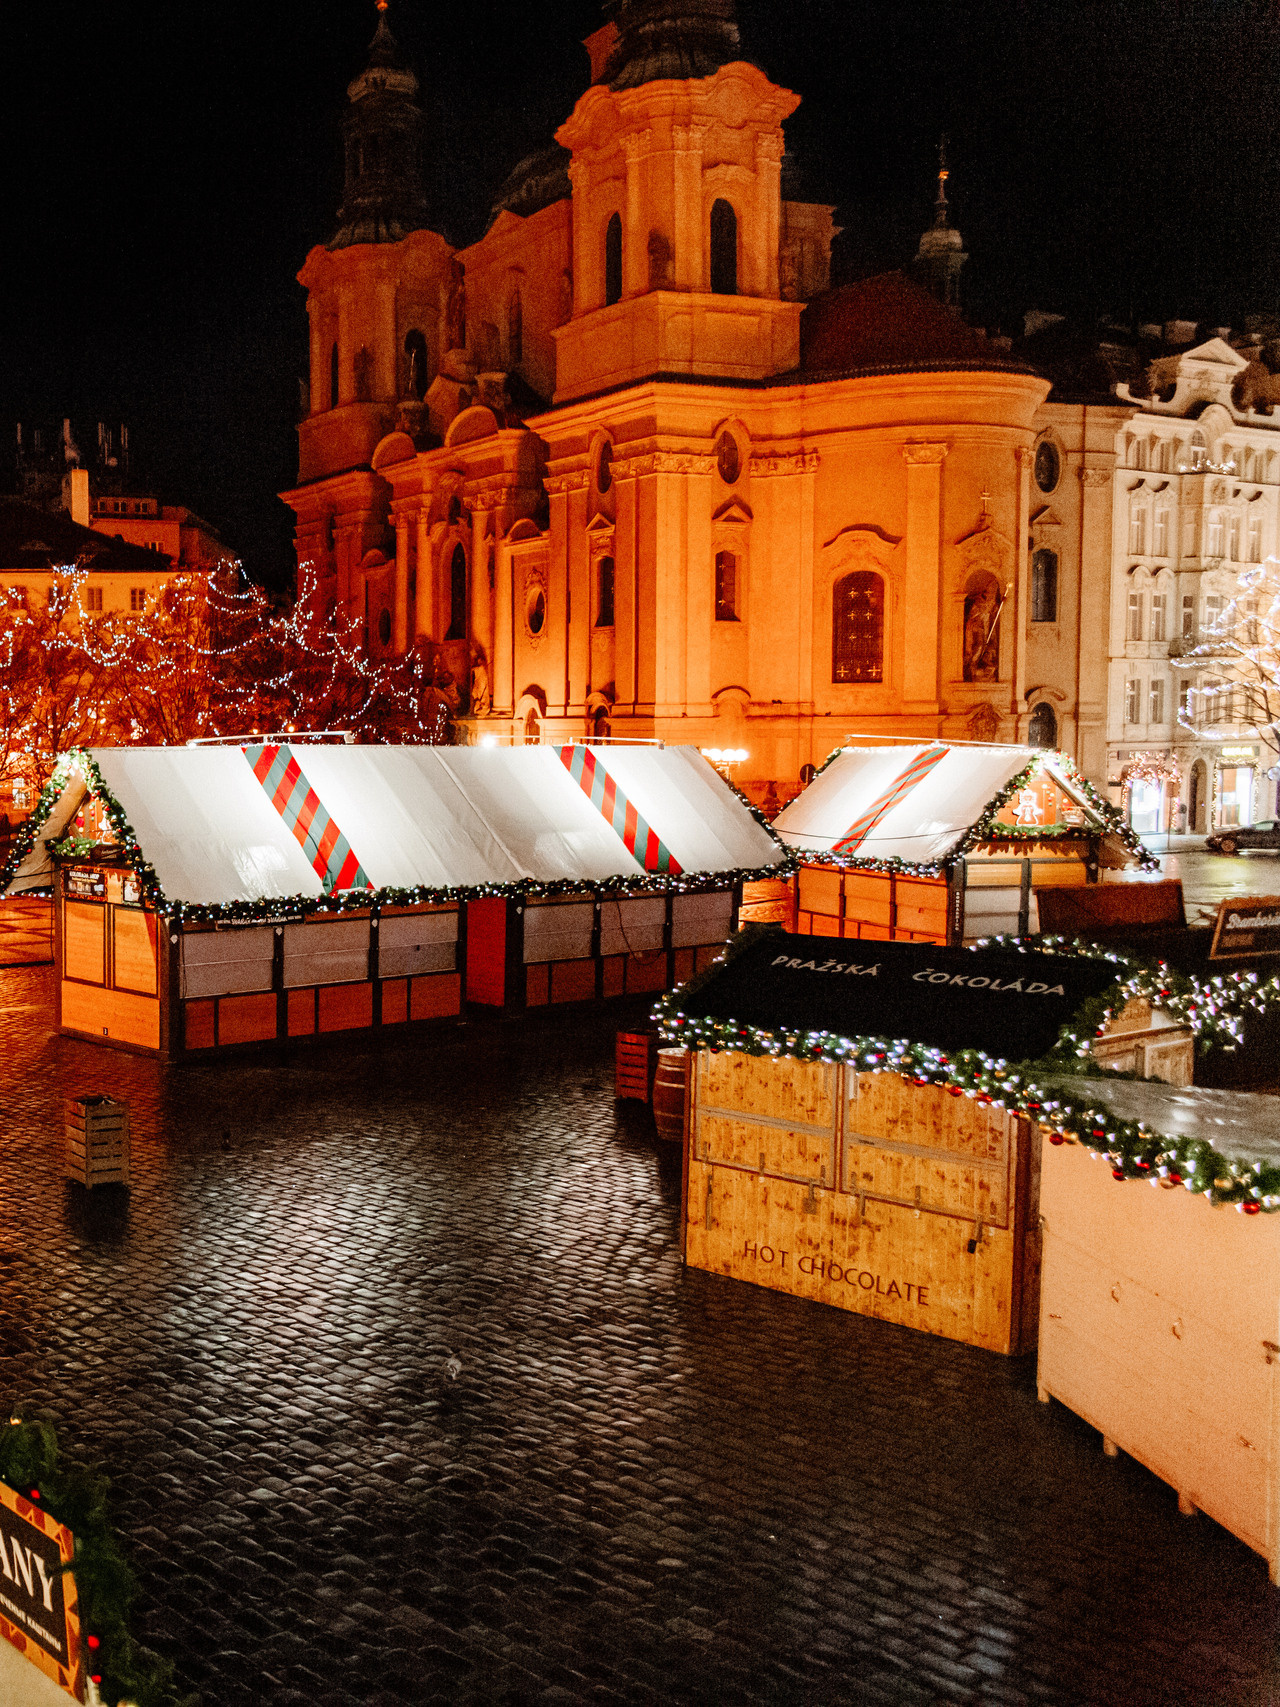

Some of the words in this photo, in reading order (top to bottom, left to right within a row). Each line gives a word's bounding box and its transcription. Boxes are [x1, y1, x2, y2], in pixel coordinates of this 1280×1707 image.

[771, 955, 881, 977] PRAŽSKÁ
[912, 968, 1065, 996] ČOKOLÁDA
[744, 1241, 789, 1268] HOT
[798, 1256, 930, 1306] CHOCOLATE
